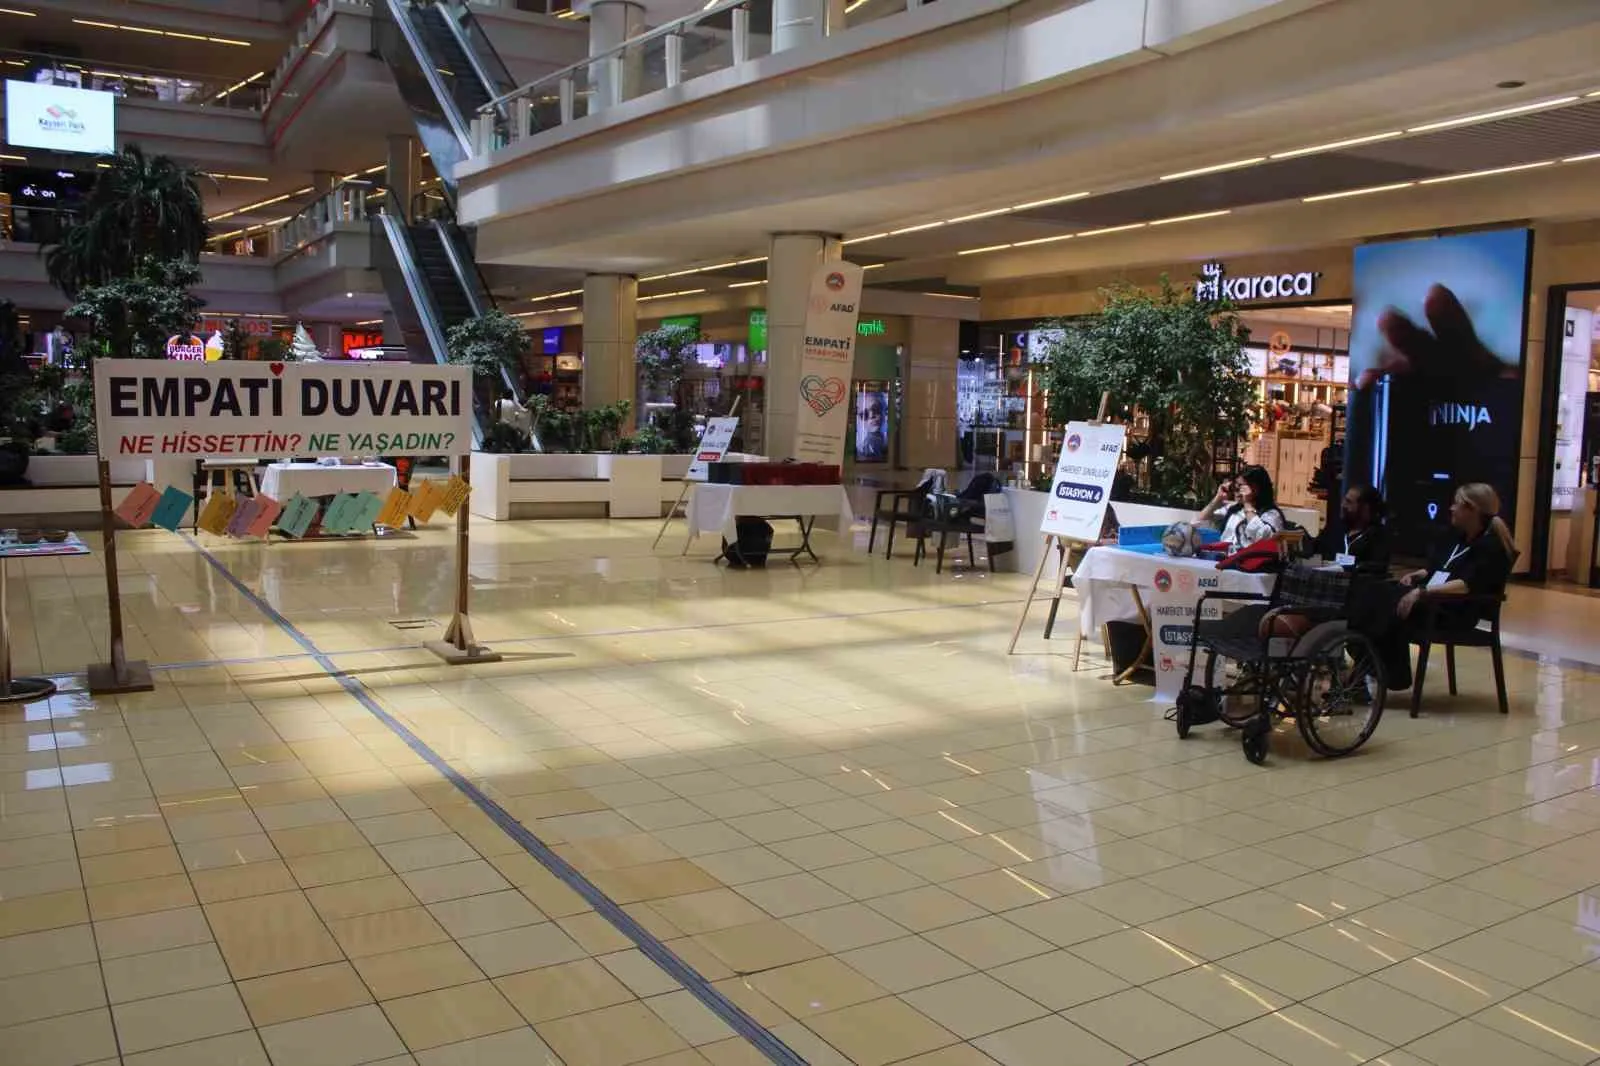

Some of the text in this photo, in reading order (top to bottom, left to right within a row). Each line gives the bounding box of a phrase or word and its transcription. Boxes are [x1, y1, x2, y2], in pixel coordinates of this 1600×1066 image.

[1221, 272, 1313, 300] karaca
[168, 345, 202, 353] BURGER
[805, 336, 851, 350] EMPATİ
[168, 353, 202, 361] KING
[109, 364, 461, 417] EMPATİ DUVARI
[119, 430, 455, 454] NE HİSSETTİN? NE YAŞADIN?
[1059, 484, 1094, 499] İSTASYON
